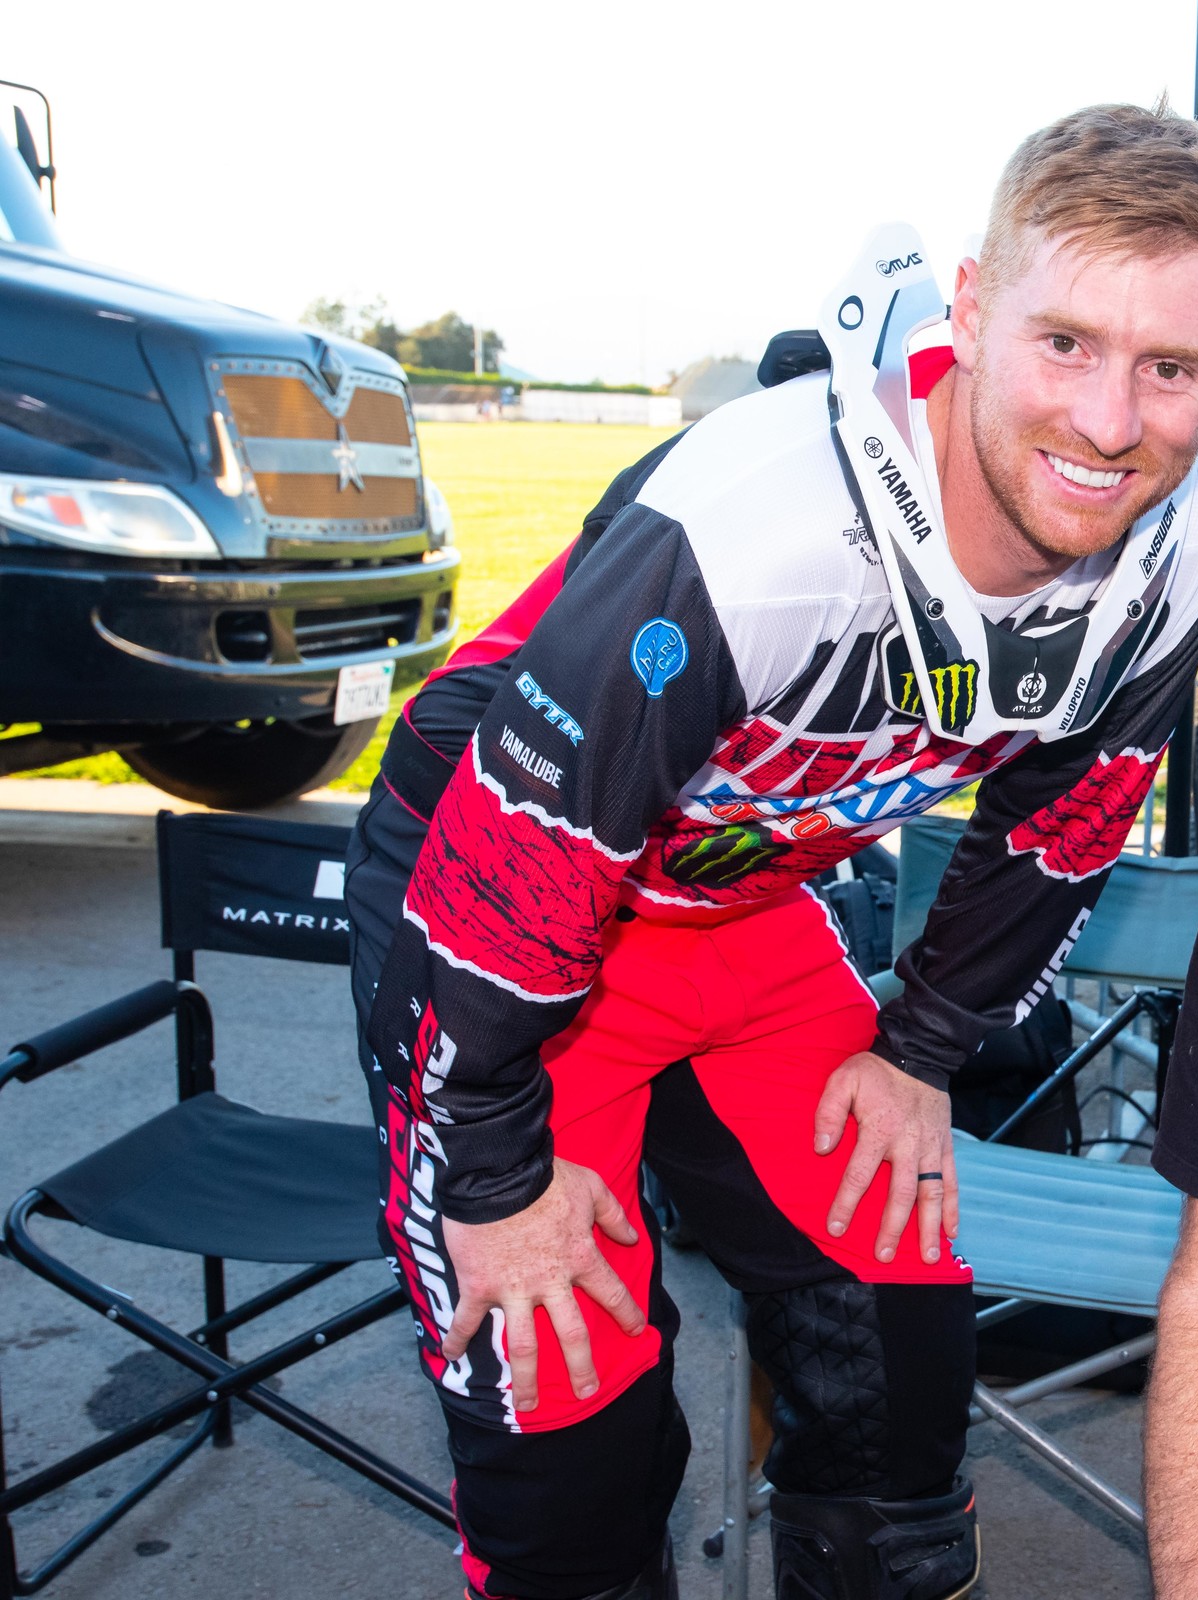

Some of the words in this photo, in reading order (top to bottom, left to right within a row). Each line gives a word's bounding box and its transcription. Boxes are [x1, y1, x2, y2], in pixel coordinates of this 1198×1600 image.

[877, 457, 932, 545] YAMAHA
[515, 671, 584, 747] GYTR
[1059, 677, 1087, 731] VILLOPOTO
[499, 724, 563, 789] YAMALUBE
[222, 906, 350, 932] MATRIX
